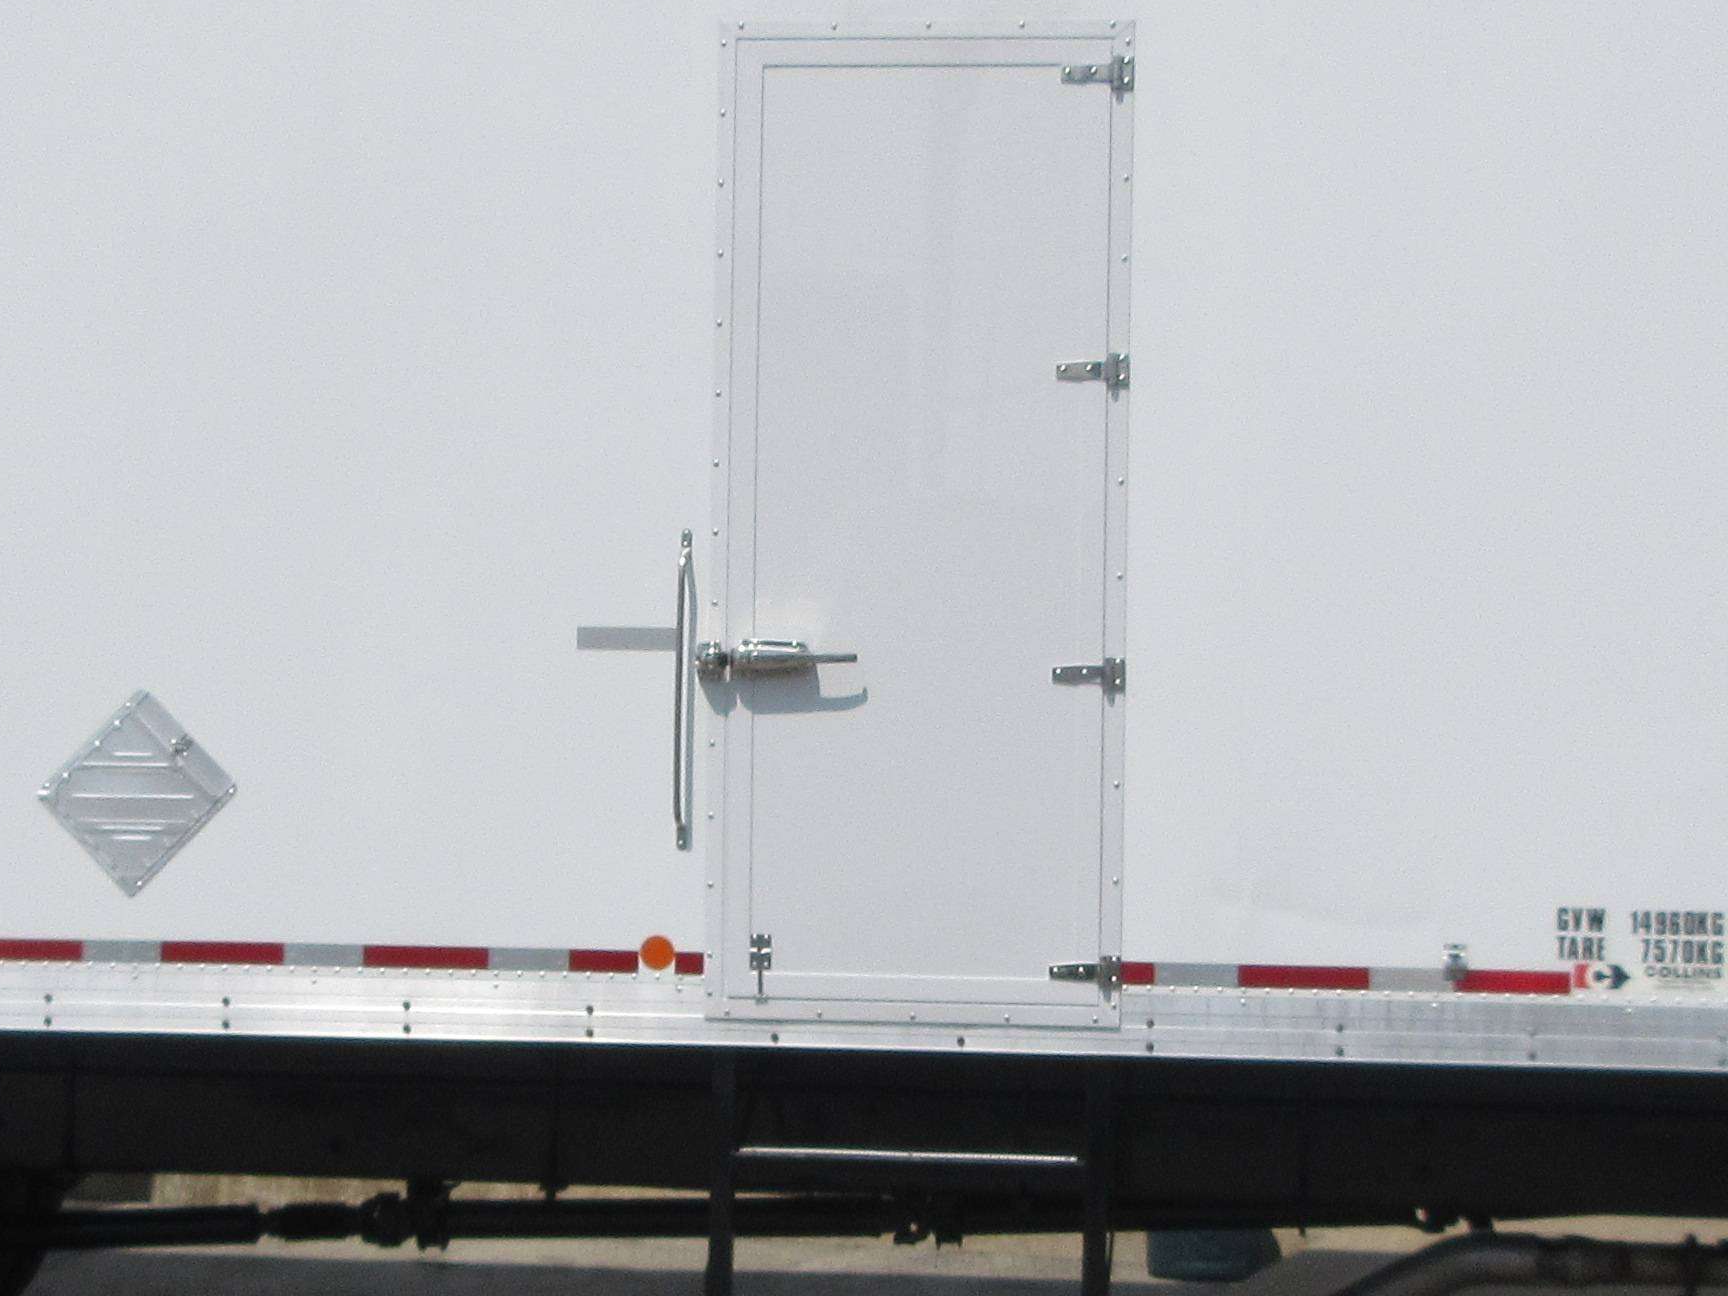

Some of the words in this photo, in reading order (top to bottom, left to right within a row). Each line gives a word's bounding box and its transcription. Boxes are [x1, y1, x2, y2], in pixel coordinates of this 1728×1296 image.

[1556, 907, 1606, 932] GVW
[1556, 936, 1605, 961] TARE
[1641, 938, 1725, 964] 7570KG
